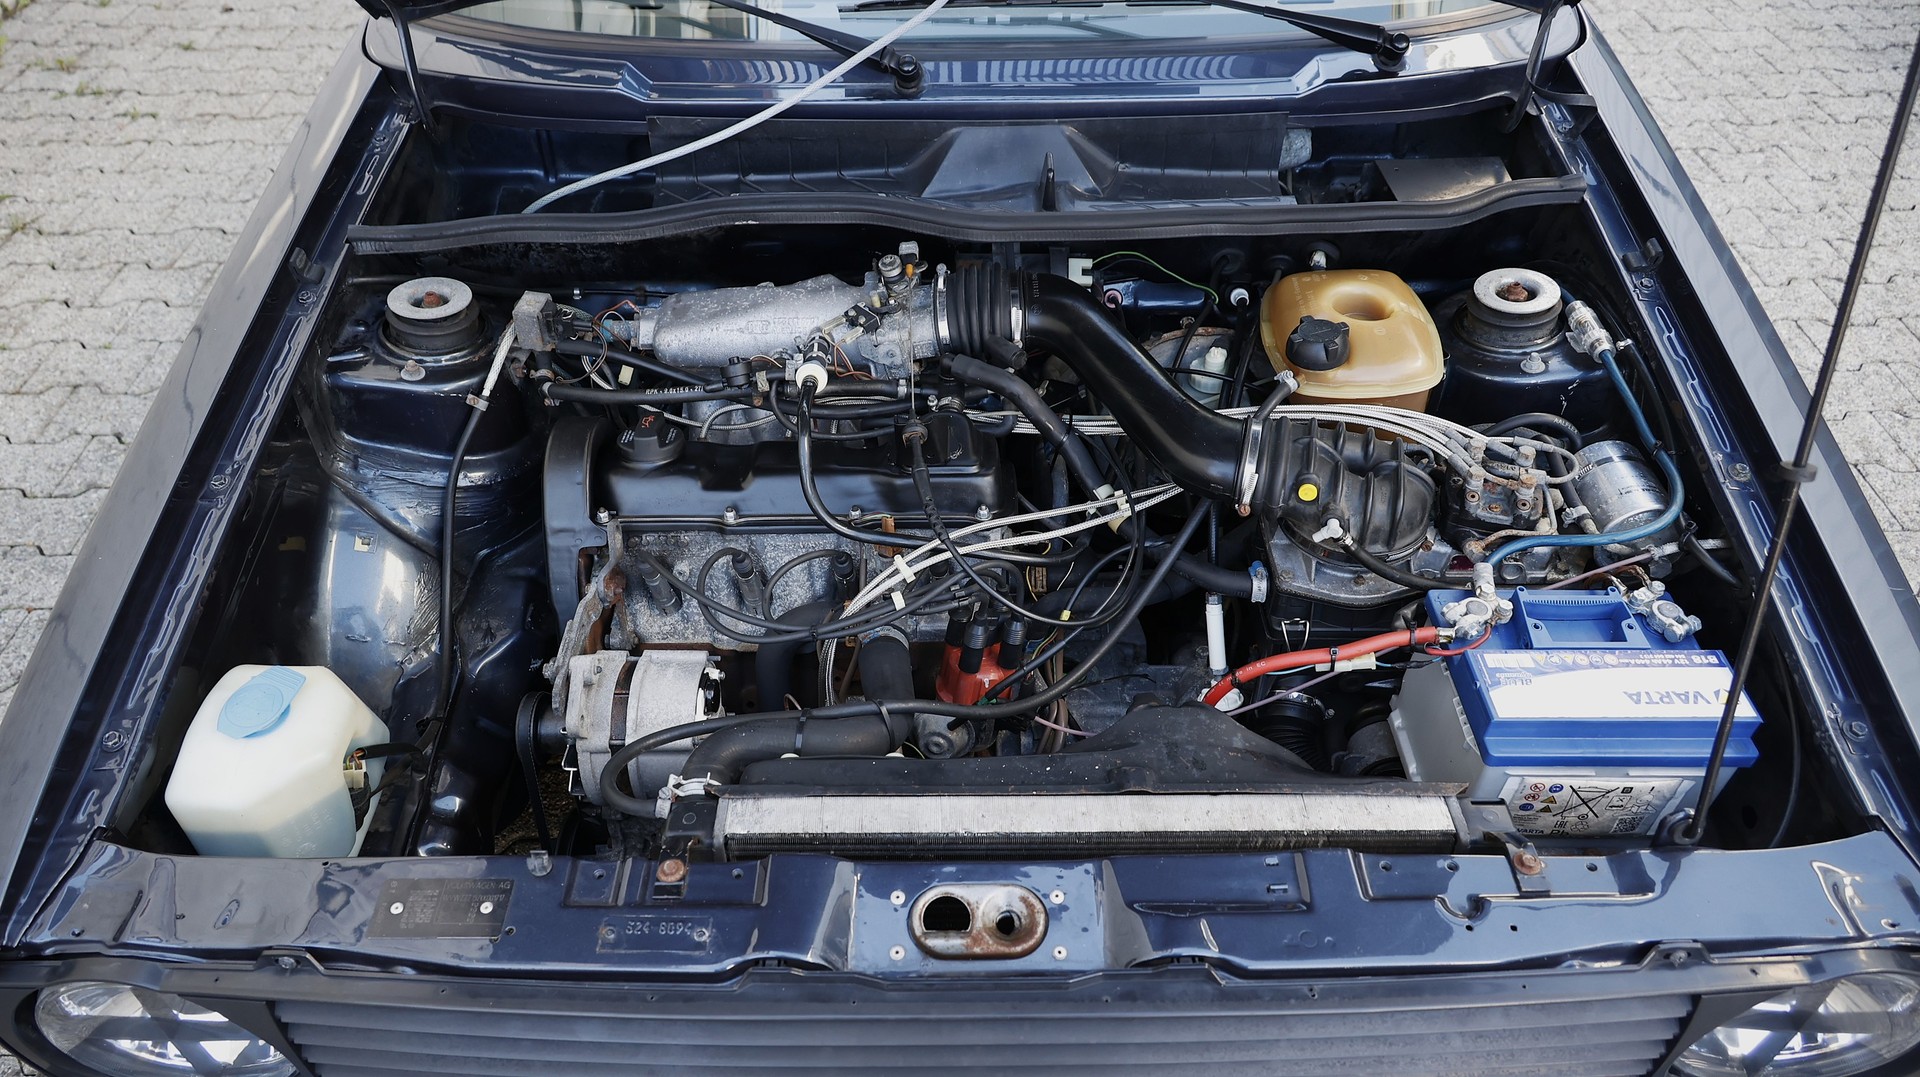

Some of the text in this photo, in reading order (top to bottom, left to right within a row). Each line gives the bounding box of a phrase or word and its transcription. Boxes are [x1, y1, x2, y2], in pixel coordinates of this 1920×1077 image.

[1690, 654, 1720, 664] B18
[1226, 670, 1243, 682] mde
[1500, 678, 1533, 686] BLUE
[1623, 690, 1712, 705] VARTA
[498, 881, 511, 889] AG
